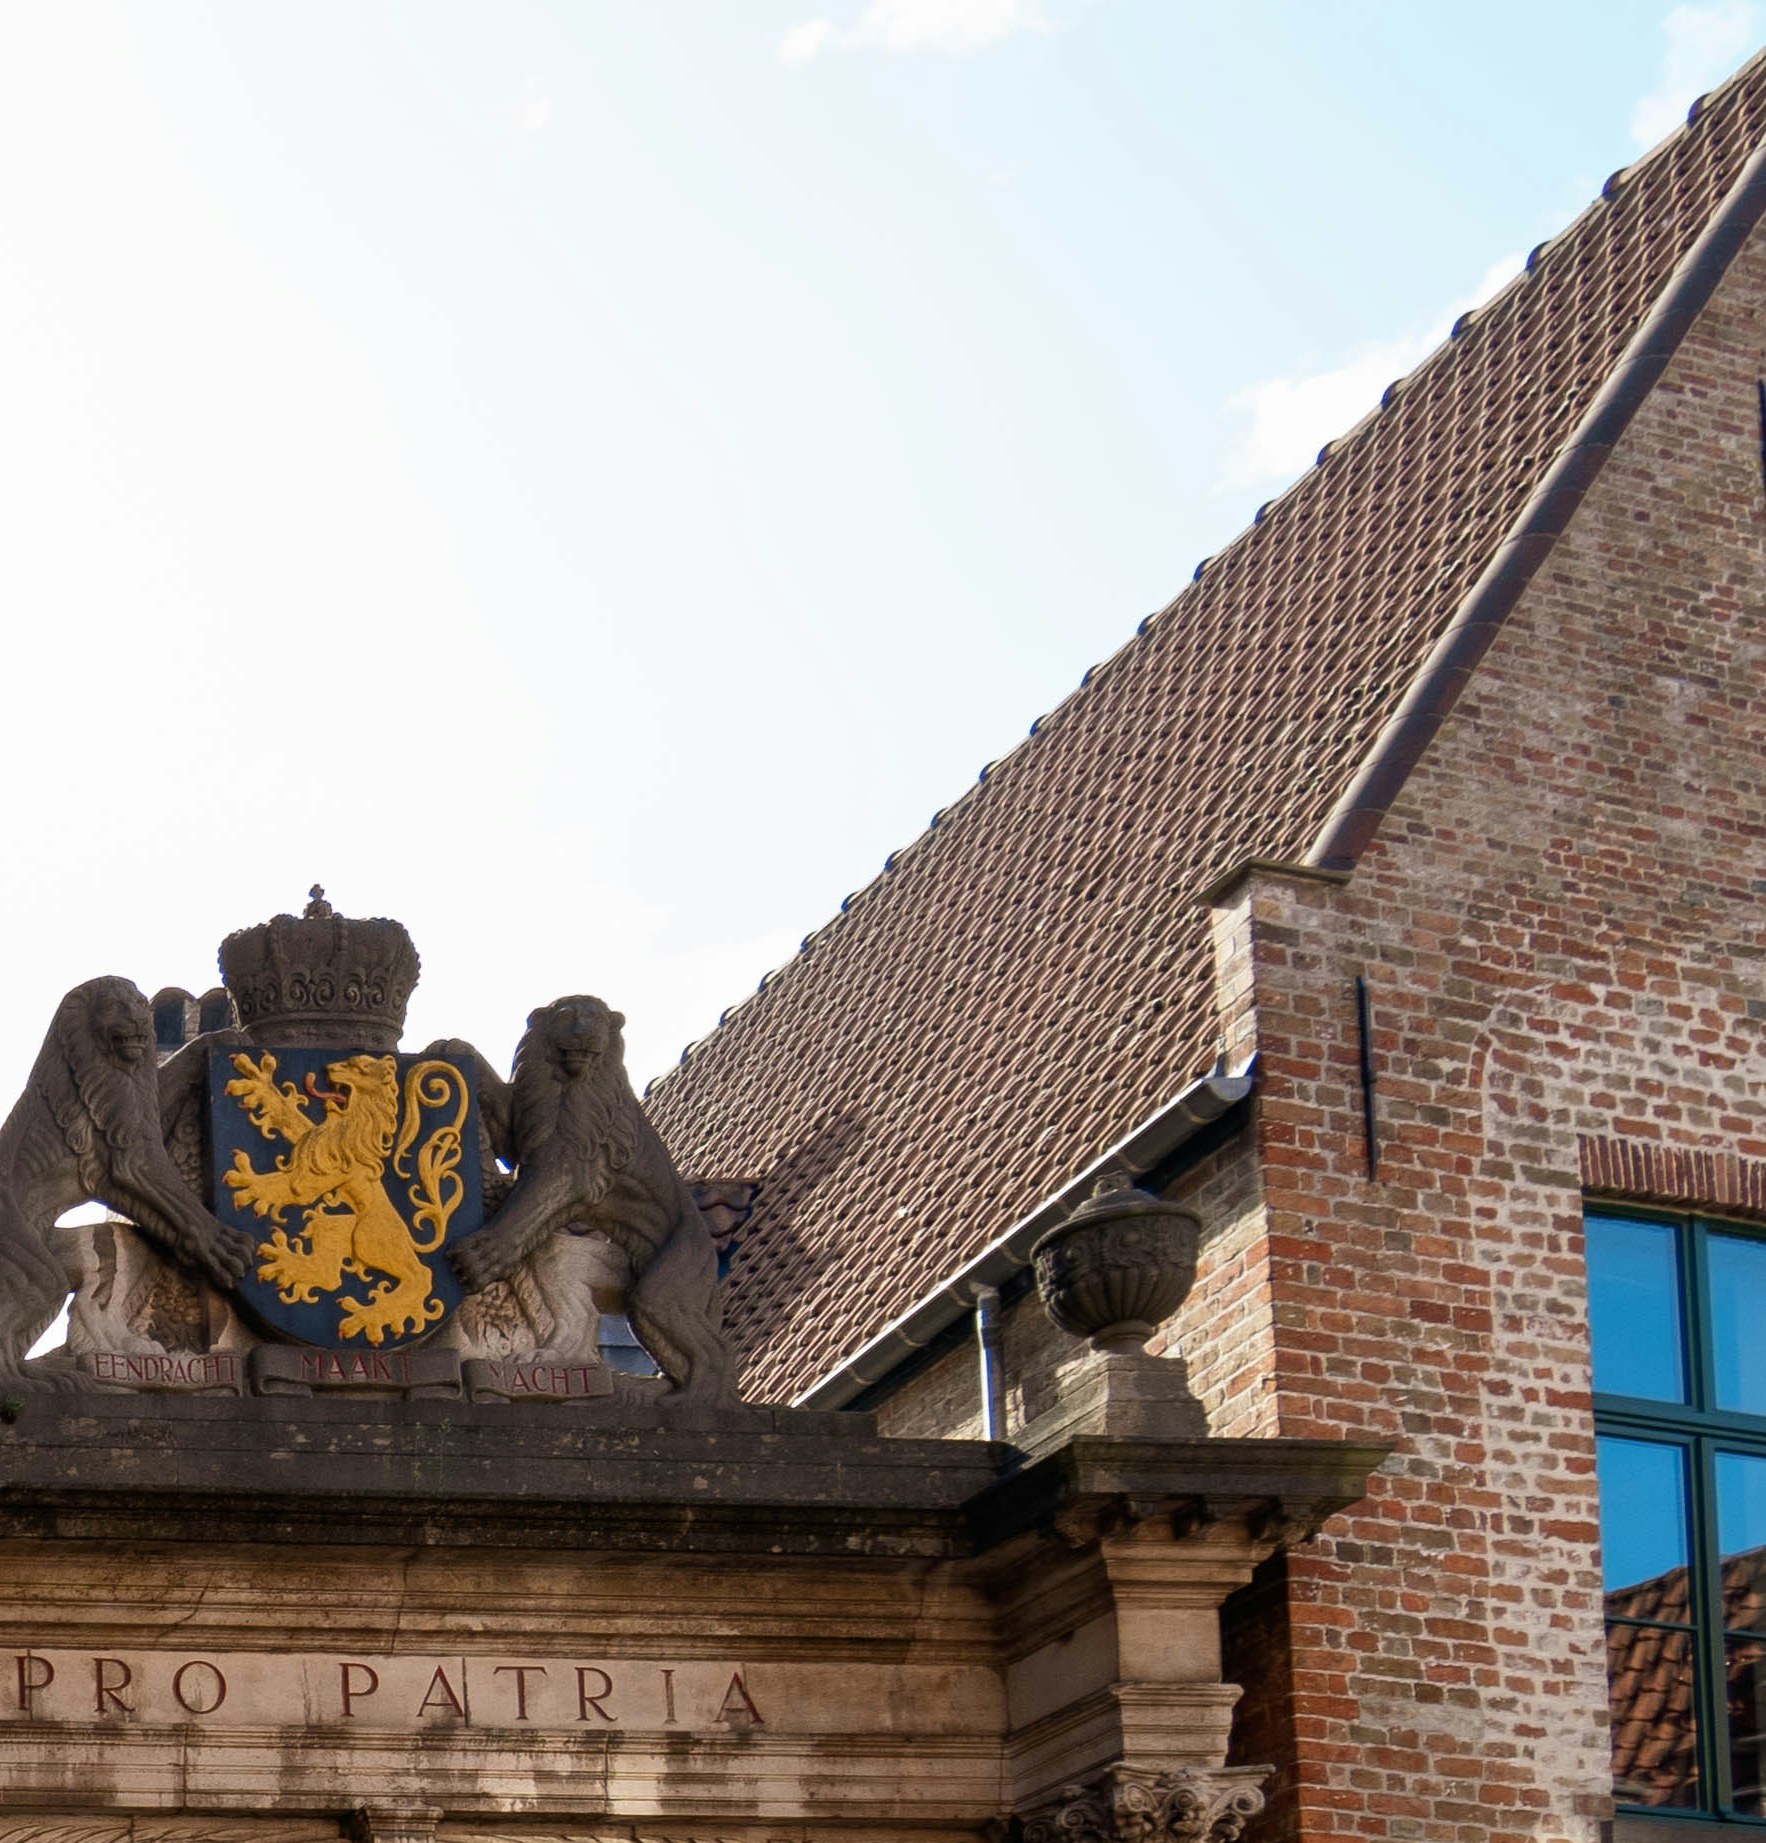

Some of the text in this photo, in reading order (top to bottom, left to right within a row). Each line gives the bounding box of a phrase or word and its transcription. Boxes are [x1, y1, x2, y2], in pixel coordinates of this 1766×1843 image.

[94, 1351, 598, 1394] EENDRACHT MAAKT MACHT
[15, 1655, 766, 1724] PRO PATRIA
